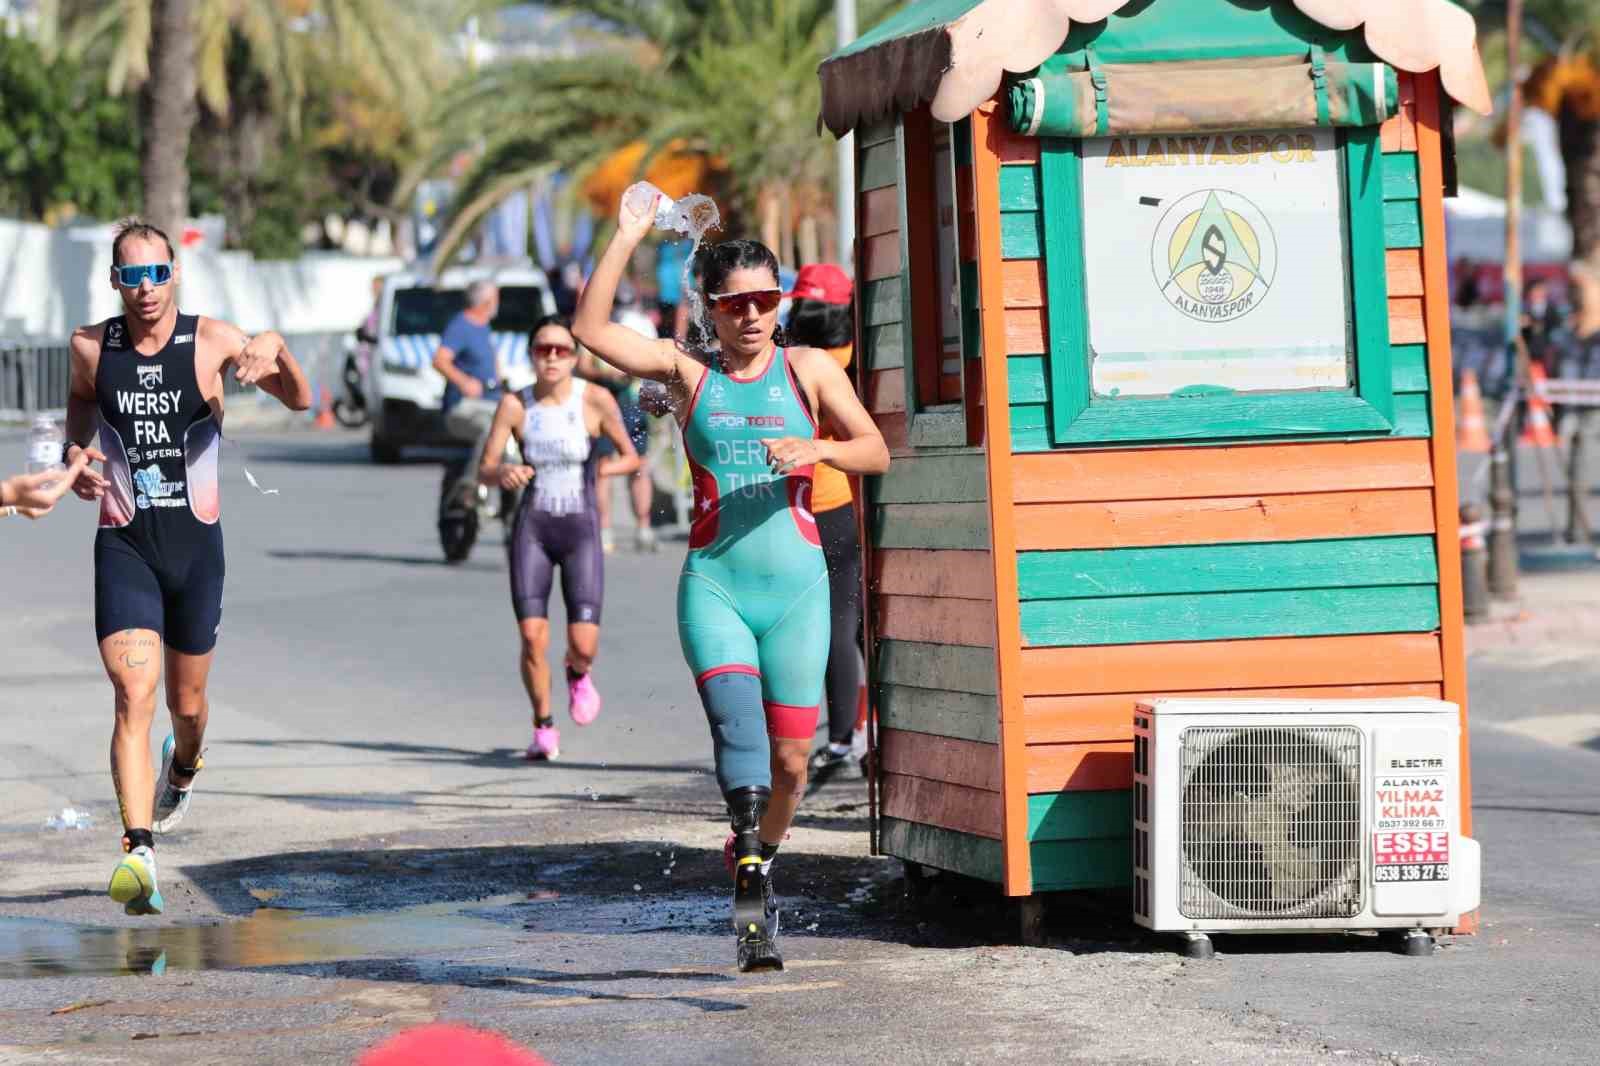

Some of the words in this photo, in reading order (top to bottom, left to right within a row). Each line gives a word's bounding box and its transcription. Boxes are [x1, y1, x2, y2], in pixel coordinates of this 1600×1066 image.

[1105, 134, 1316, 167] ALANYASPOR
[1174, 292, 1254, 319] ALANYASPOR
[117, 390, 182, 415] WERSY
[134, 420, 171, 445] FRA
[145, 448, 182, 460] SFERIS
[725, 473, 776, 498] TUR
[1391, 758, 1444, 768] ELECTRA
[1382, 778, 1440, 787] ALANYA
[1376, 789, 1444, 803] YILMAZ
[1376, 831, 1448, 853] ESSE
[1376, 865, 1400, 881] 0538
[1401, 865, 1421, 880] 336
[1422, 865, 1435, 880] 27
